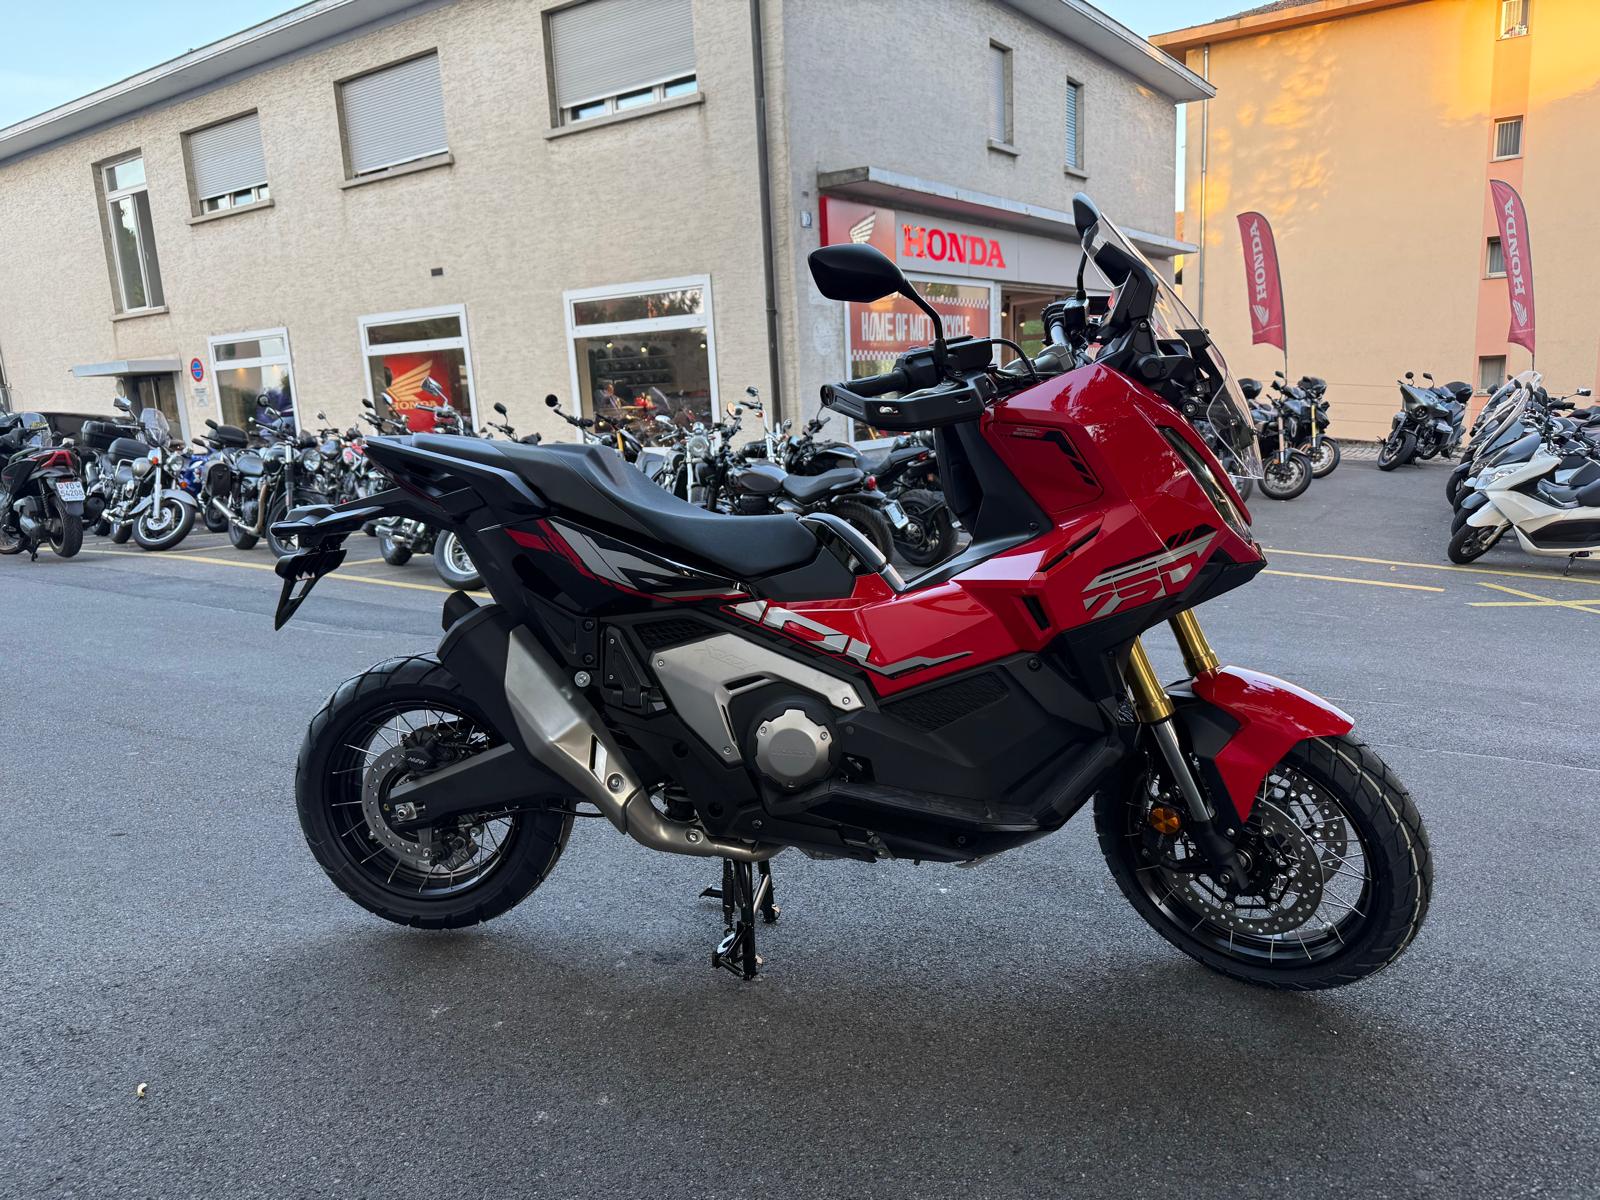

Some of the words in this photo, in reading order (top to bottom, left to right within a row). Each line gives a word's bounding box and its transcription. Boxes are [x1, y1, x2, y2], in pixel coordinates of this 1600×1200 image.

[901, 223, 1007, 269] HONDA
[1249, 218, 1268, 302] HONDA
[1503, 195, 1526, 297] HONDA
[861, 311, 894, 341] HOME
[895, 312, 909, 341] OF
